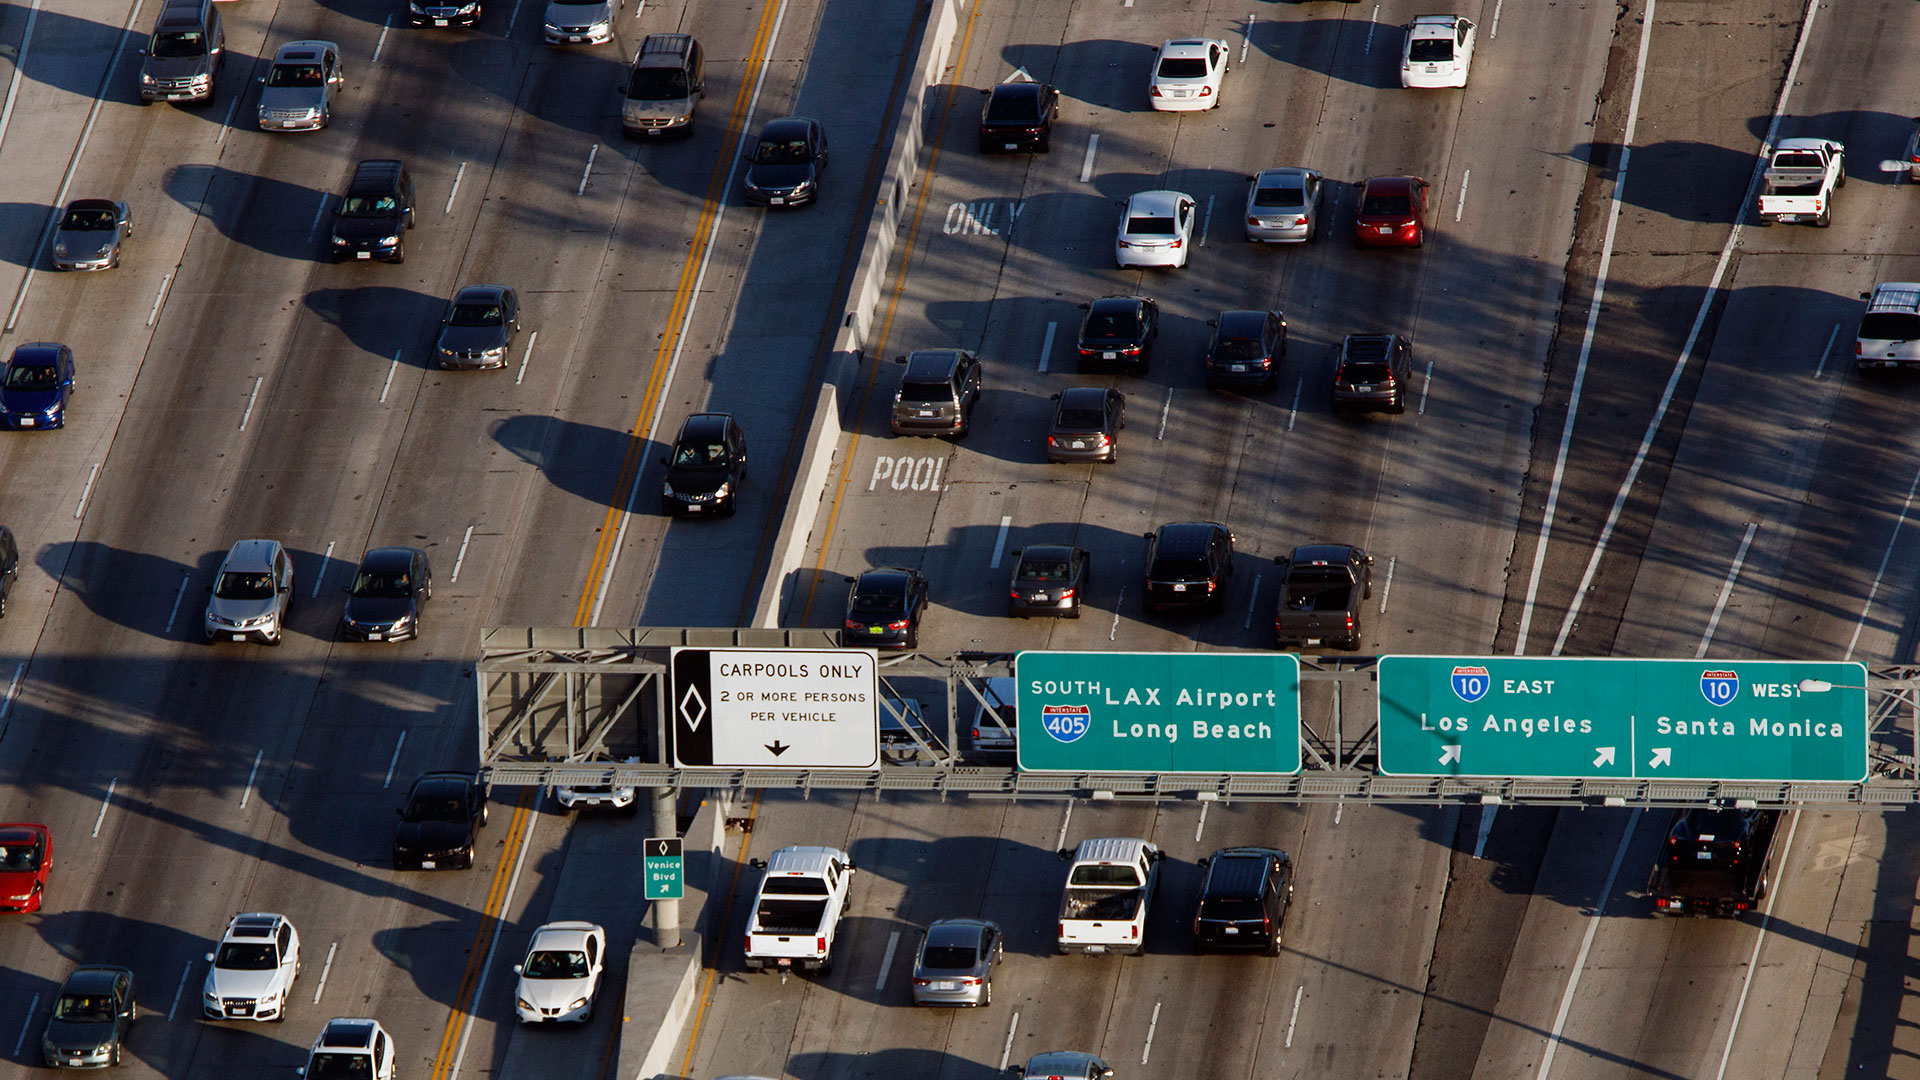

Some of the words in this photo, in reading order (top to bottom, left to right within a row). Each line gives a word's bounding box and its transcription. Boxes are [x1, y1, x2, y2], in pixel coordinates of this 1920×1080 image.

[943, 202, 1025, 235] ONLY
[869, 456, 949, 492] POOL
[720, 663, 809, 678] CARPOOLS
[819, 665, 862, 678] ONLY
[1031, 680, 1100, 695] SOUTH
[1460, 678, 1481, 695] 10
[1503, 680, 1555, 694] EAST
[1710, 682, 1730, 699] 10
[720, 690, 730, 702] 2
[737, 691, 754, 701] OR
[761, 692, 797, 702] MORE
[805, 693, 866, 702] PERSONS
[1106, 687, 1160, 705] LAX
[1176, 688, 1276, 709] Airport
[750, 712, 775, 721] PER
[782, 712, 836, 722] VEHICLE
[1048, 717, 1085, 734] 405
[1421, 713, 1468, 732] Los
[1483, 714, 1592, 738] Angeles
[1113, 720, 1178, 743] Long
[1193, 720, 1271, 739] Beach
[1657, 716, 1735, 736] Santa
[1750, 718, 1843, 737] Monica
[647, 861, 681, 869] Venice
